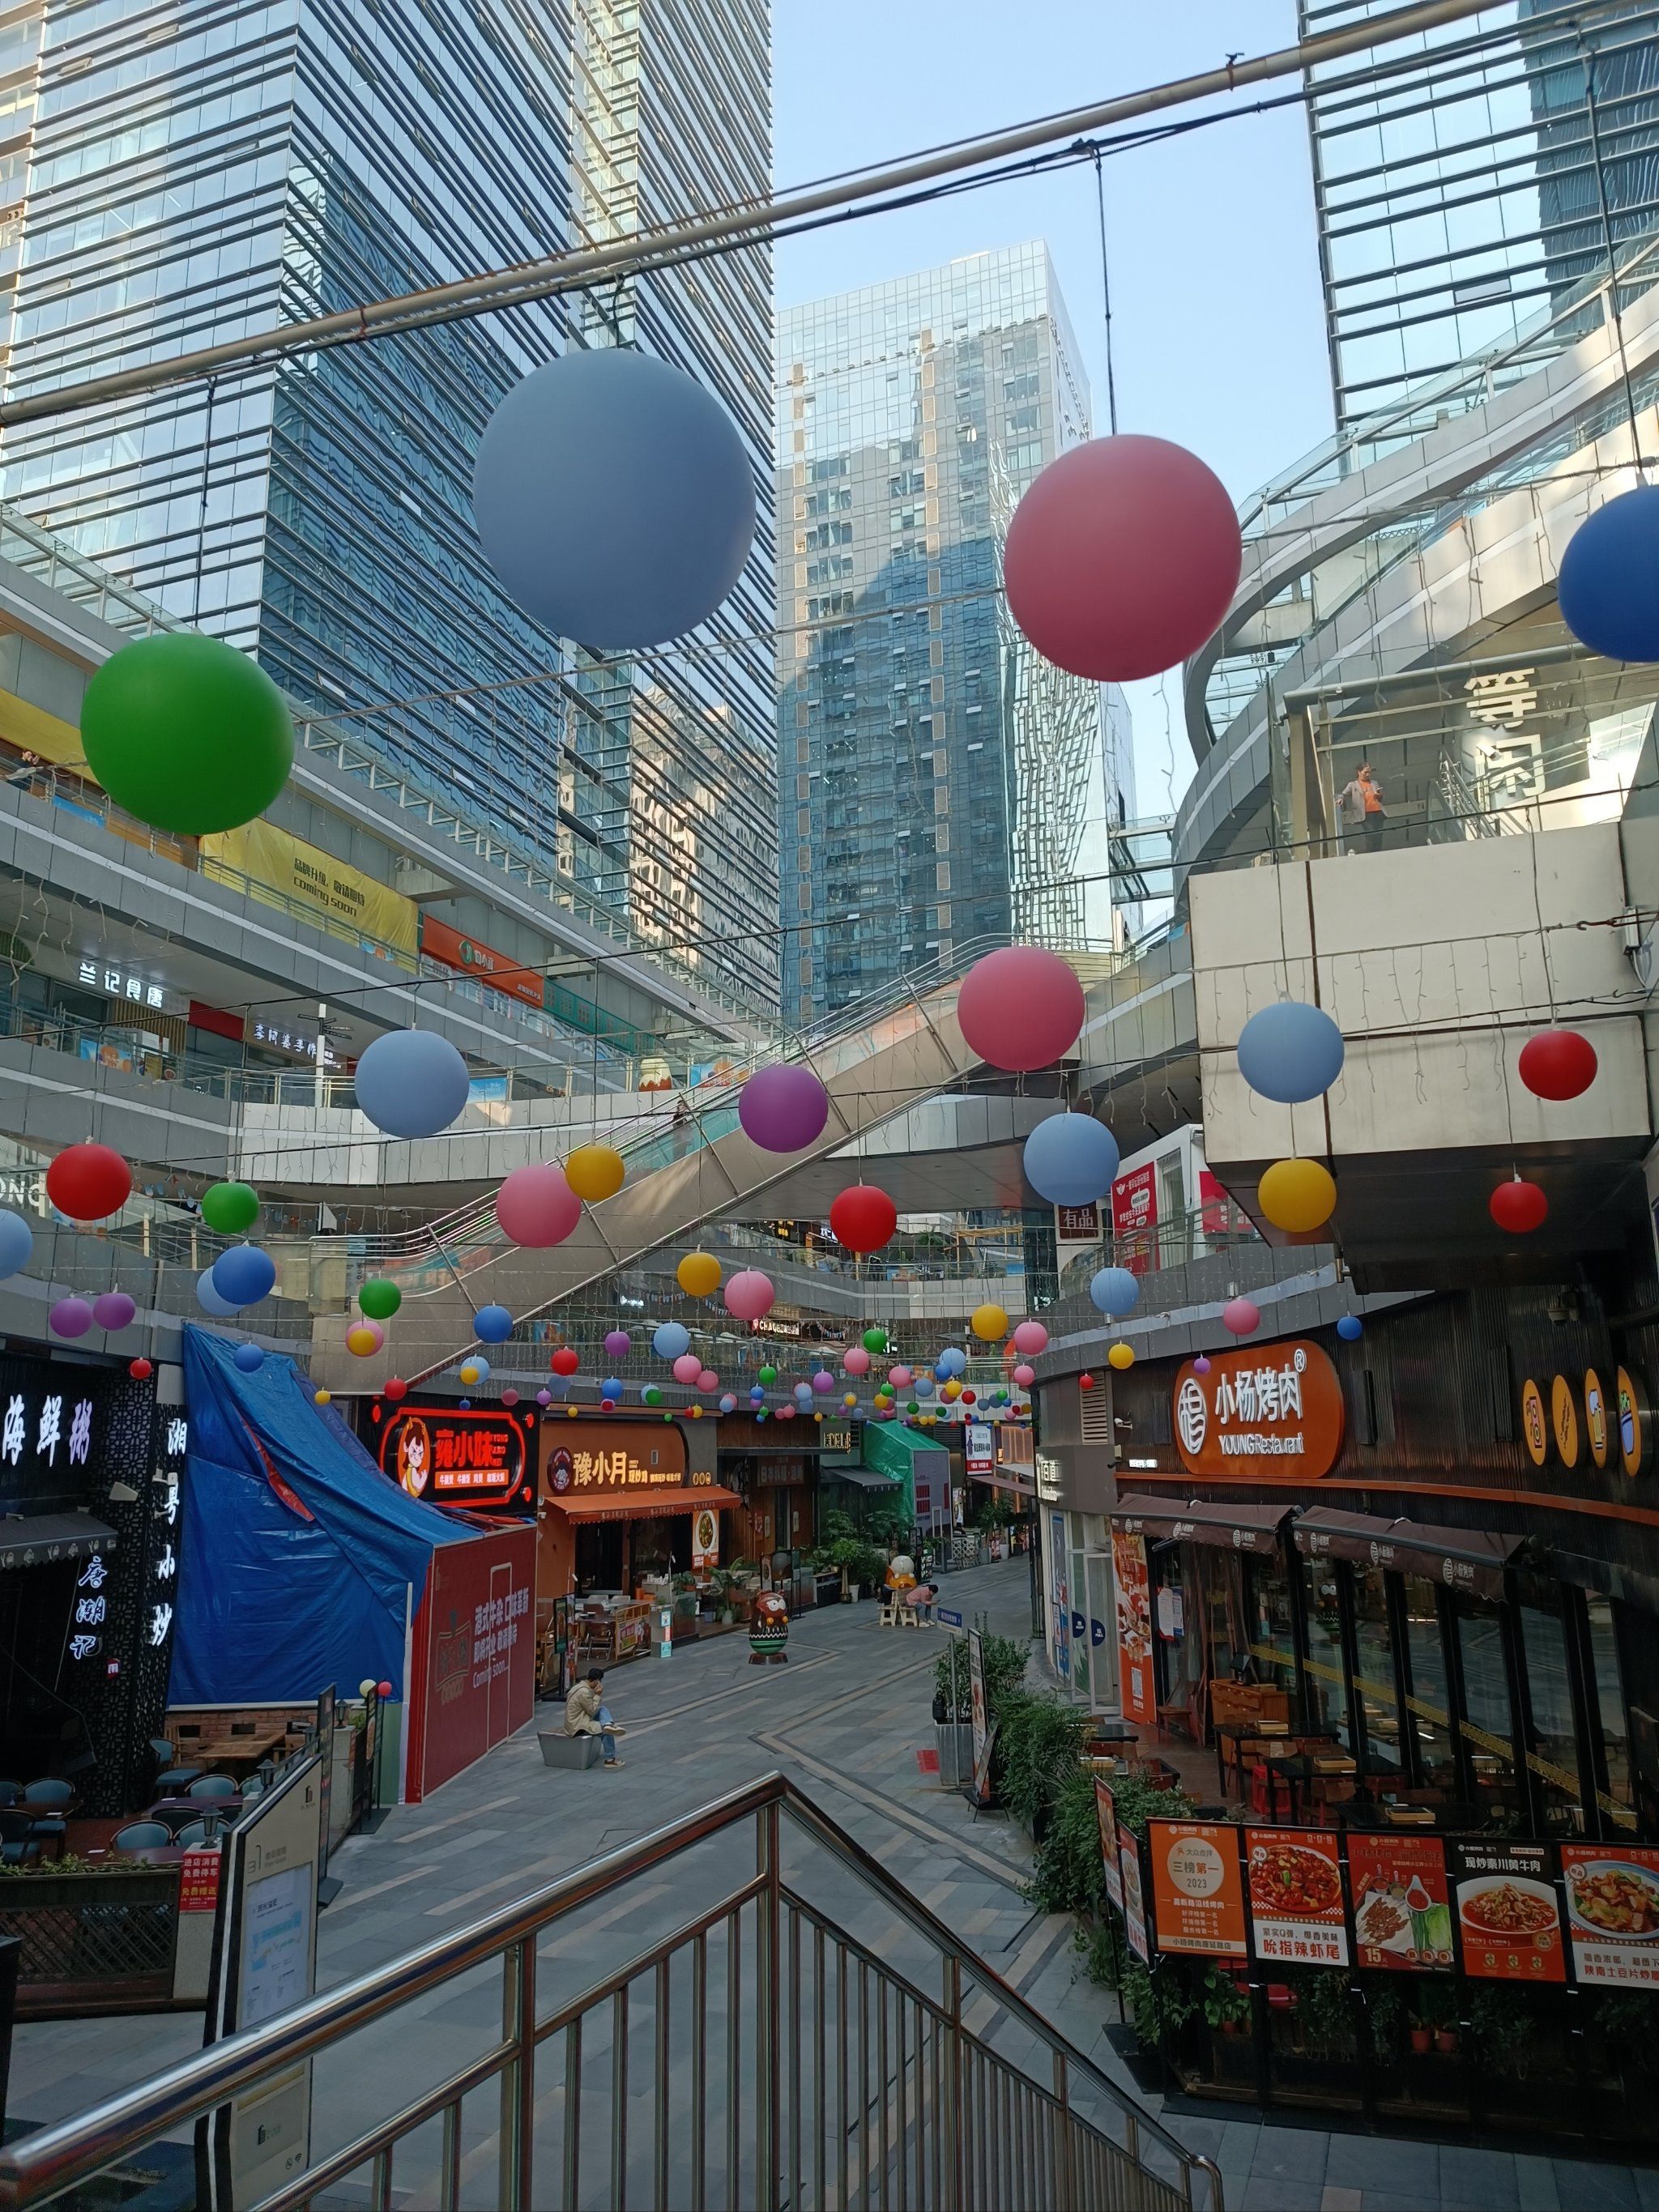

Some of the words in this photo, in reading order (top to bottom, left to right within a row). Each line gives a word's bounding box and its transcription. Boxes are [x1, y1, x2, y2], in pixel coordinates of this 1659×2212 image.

[293, 876, 329, 906] coming
[331, 897, 357, 917] soon
[1063, 1208, 1094, 1228] 有品
[1215, 1363, 1303, 1425] 小杨烤肉
[2, 1394, 92, 1467] 海鲜粥
[573, 1451, 628, 1486] 豫小月
[1186, 1848, 1213, 1857] 大众点评
[1172, 1861, 1219, 1874] 三榜第一
[1465, 1856, 1541, 1872] 现炒秦川黄牛肉
[1187, 1877, 1207, 1889] 2023
[1263, 1939, 1340, 1960] 吮指辣虾尾
